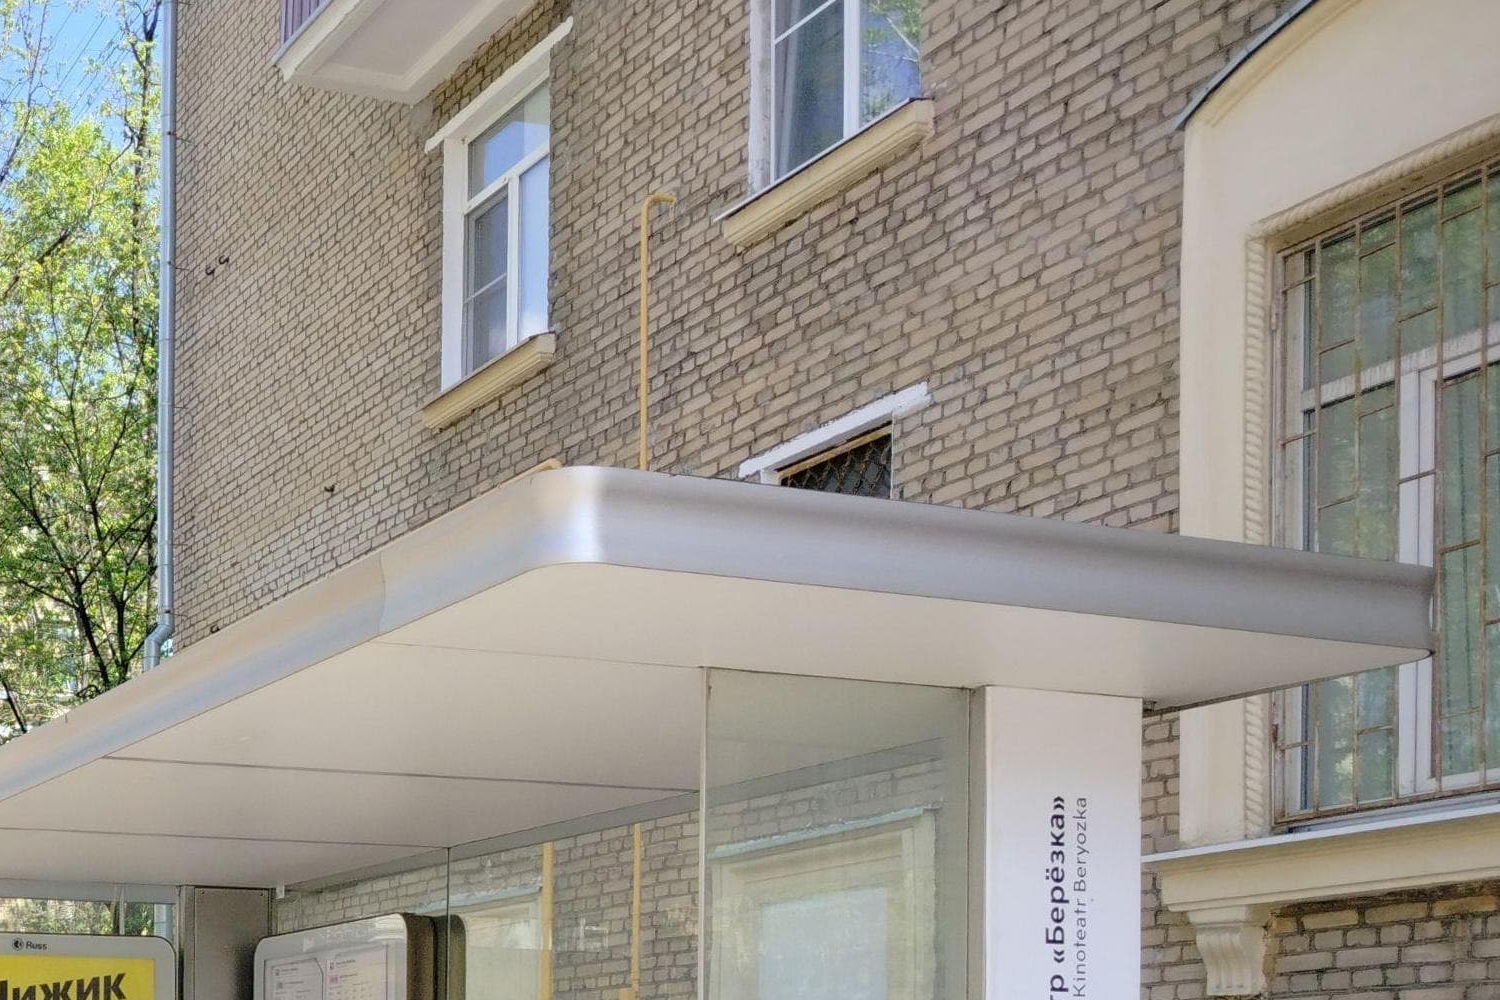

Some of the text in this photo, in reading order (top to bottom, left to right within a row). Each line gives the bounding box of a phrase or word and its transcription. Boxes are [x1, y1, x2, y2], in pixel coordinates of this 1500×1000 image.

[25, 940, 48, 950] Russ
[1045, 796, 1069, 964] «Берёзка»
[1072, 797, 1089, 998] Kinoteatr Beryozka
